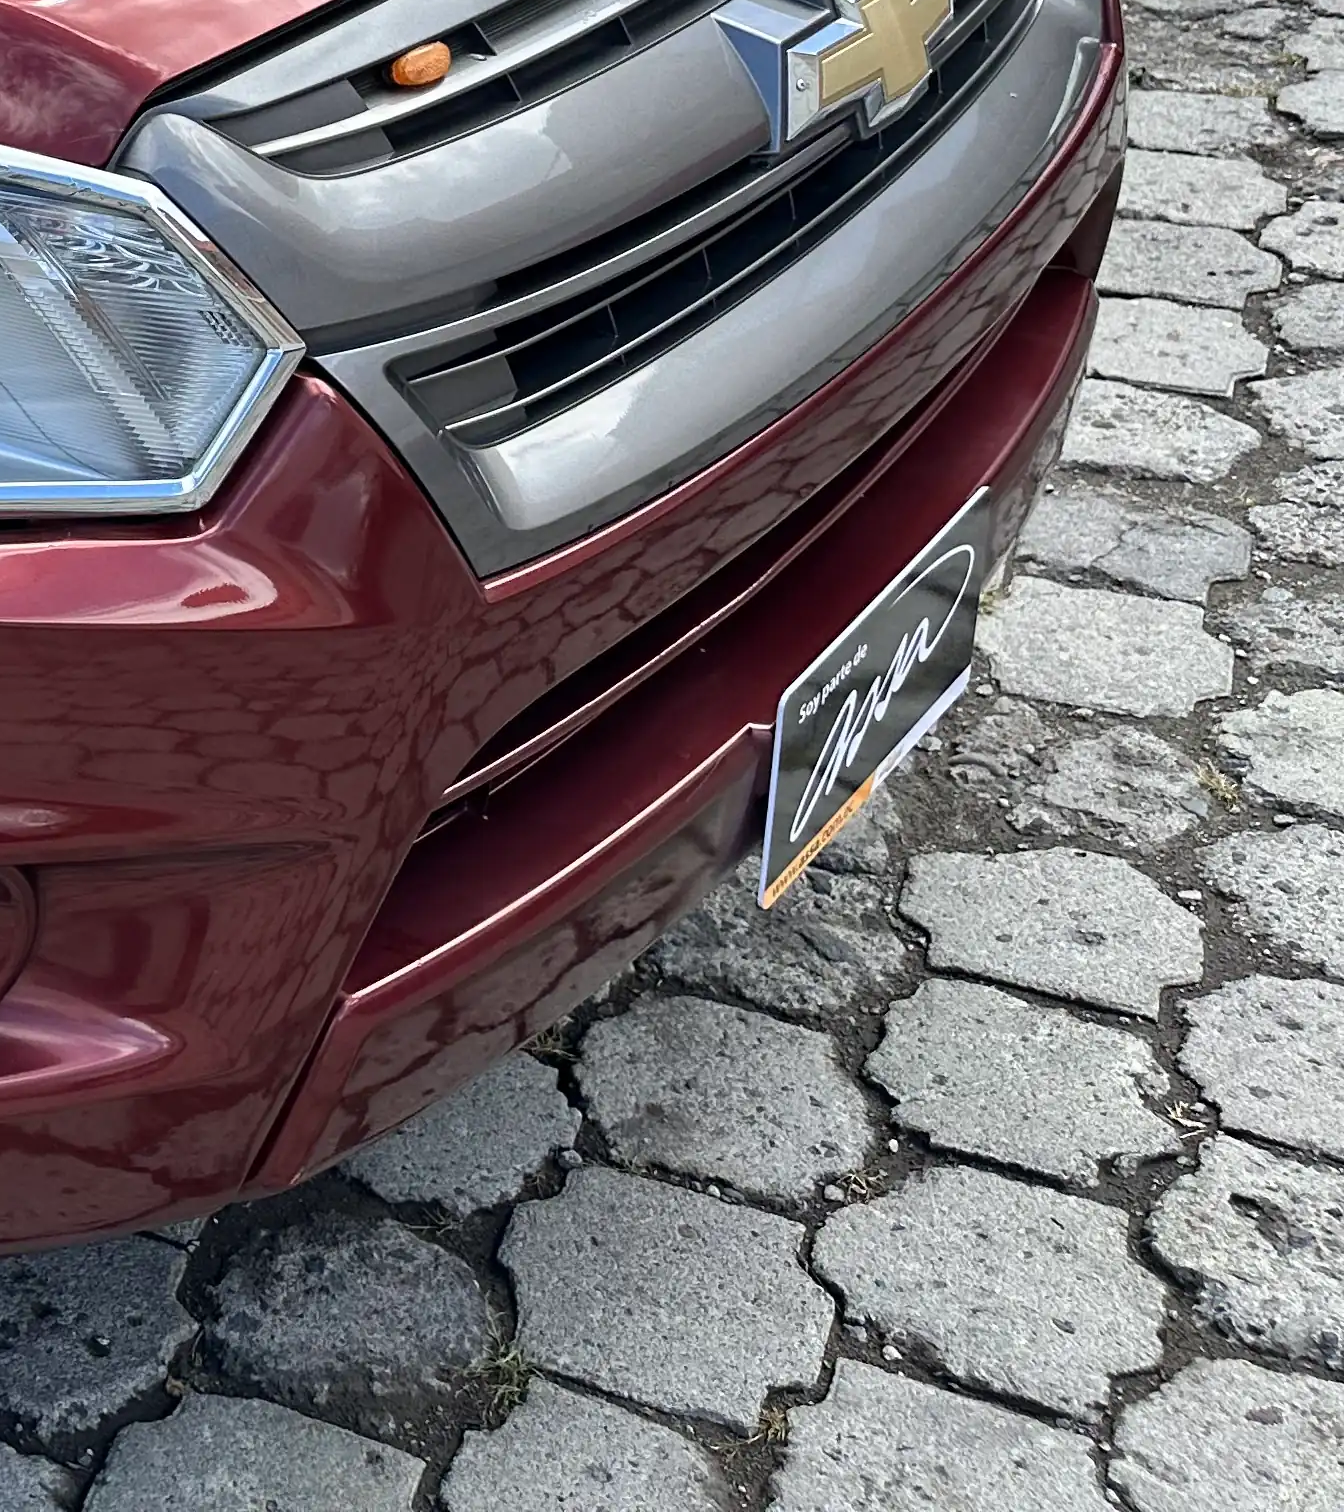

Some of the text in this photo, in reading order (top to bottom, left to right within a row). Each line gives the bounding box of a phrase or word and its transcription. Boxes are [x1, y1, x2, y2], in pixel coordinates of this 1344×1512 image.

[798, 643, 868, 725] Soy parte de
